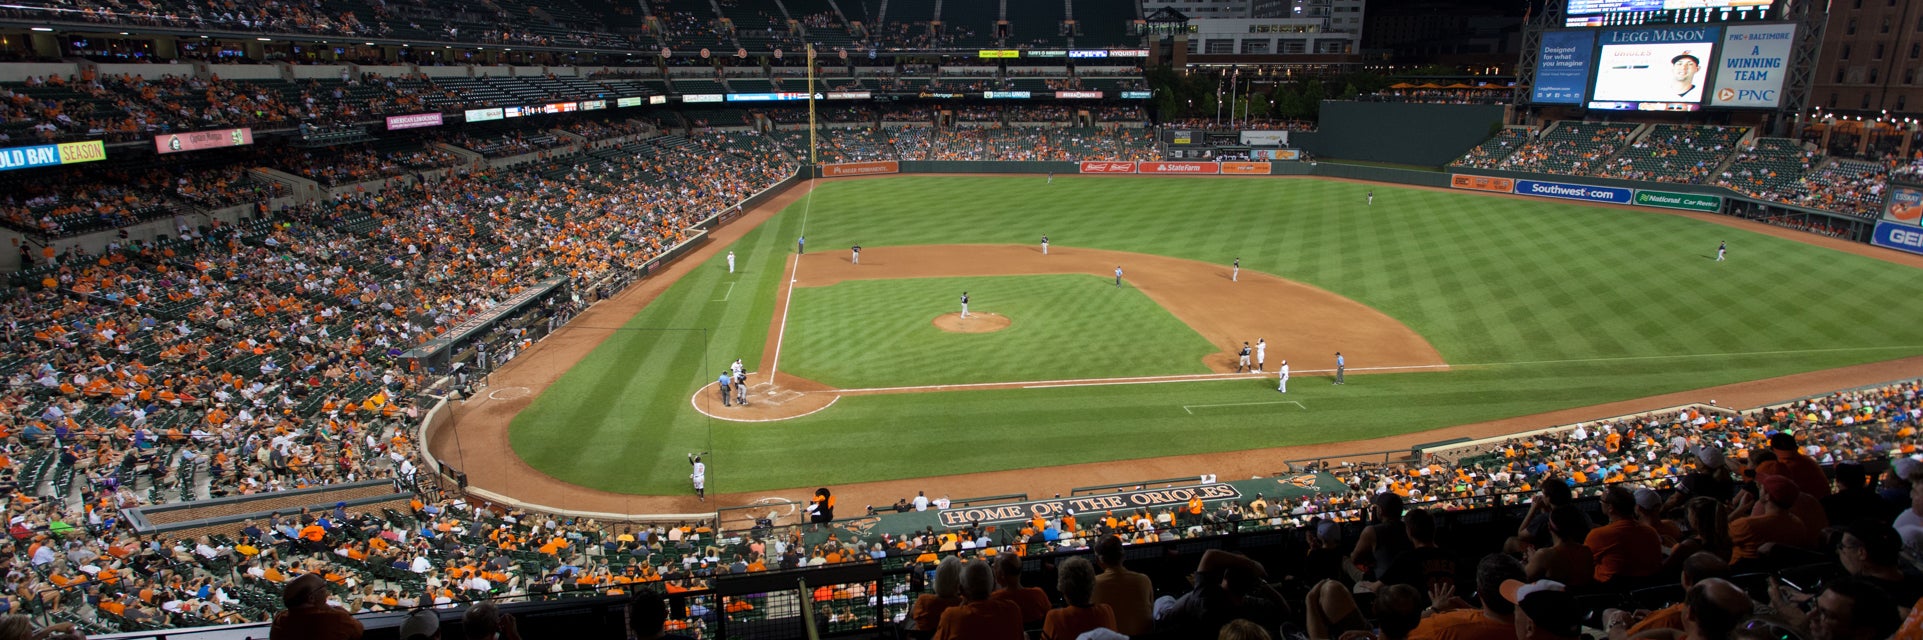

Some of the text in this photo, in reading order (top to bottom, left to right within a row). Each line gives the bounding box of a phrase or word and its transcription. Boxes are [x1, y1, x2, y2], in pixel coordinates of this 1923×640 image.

[1612, 30, 1705, 42] LEGG MASON
[1751, 45, 1759, 56] A
[1727, 58, 1781, 68] WINNING
[1735, 71, 1768, 80] TEAM
[1738, 89, 1775, 101] PNC
[64, 142, 102, 161] SEASON
[1649, 195, 1681, 204] National
[944, 484, 1235, 524] HOME OF THE ORIOLES
